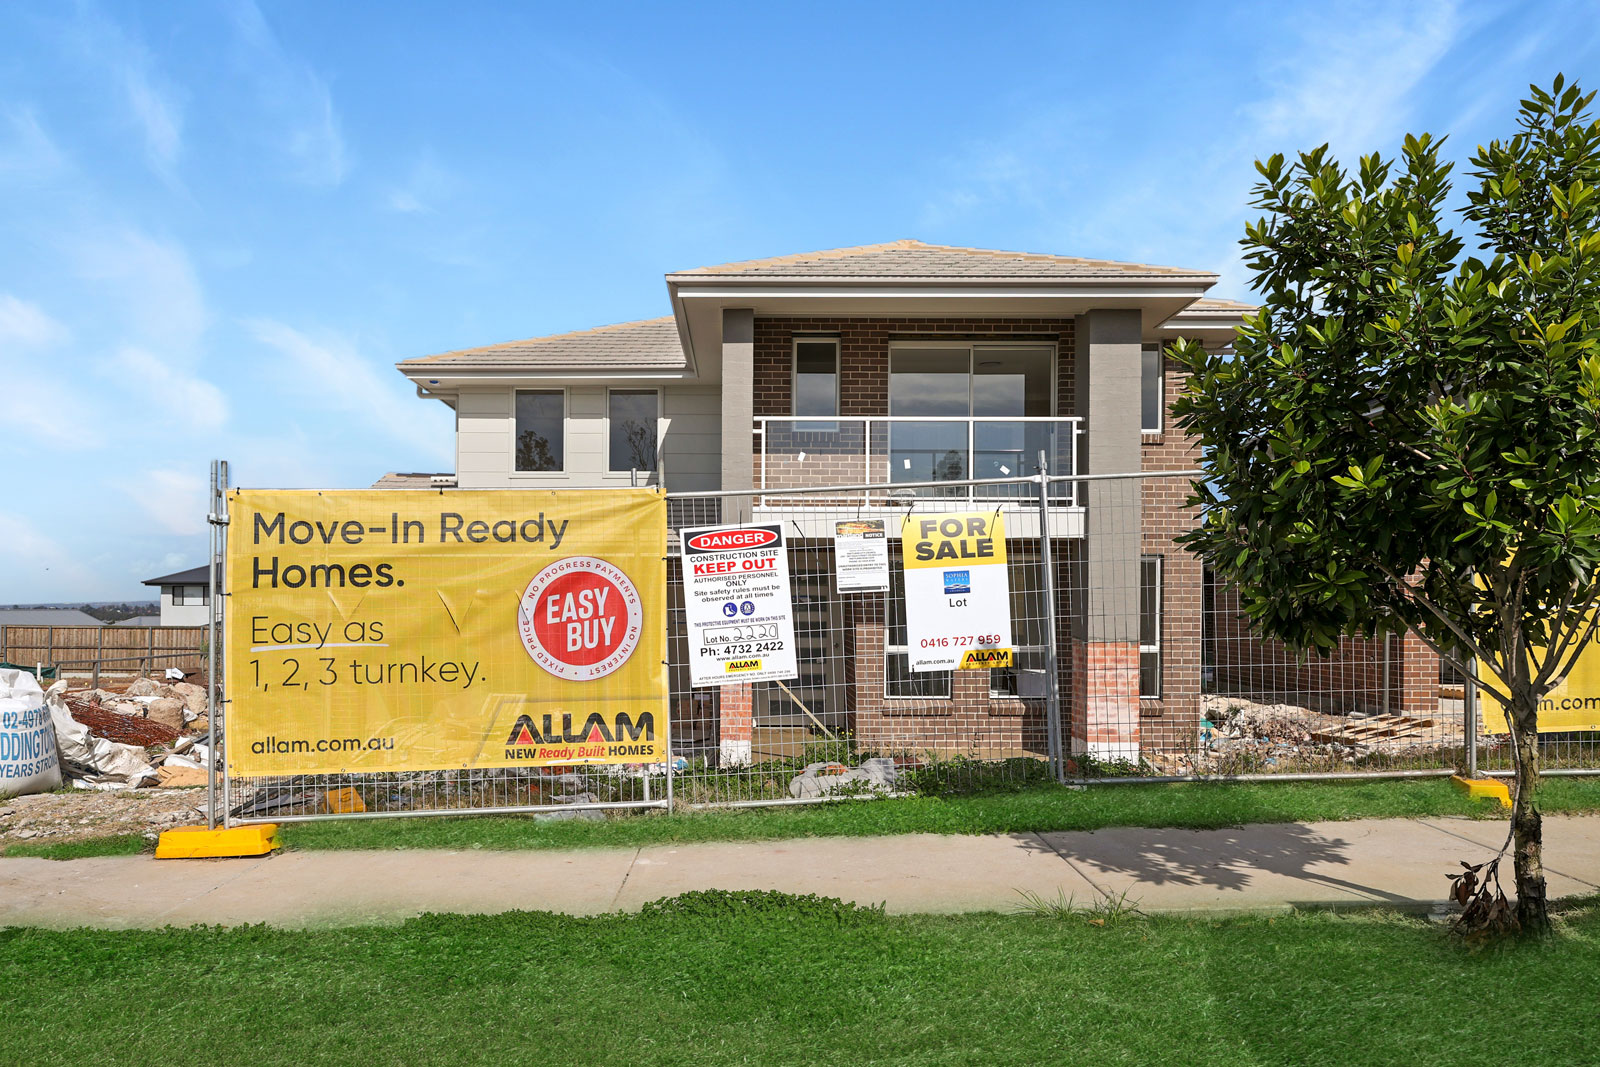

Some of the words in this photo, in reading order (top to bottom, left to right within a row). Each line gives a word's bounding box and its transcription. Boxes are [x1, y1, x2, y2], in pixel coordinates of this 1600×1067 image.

[253, 511, 425, 545] Move-In
[439, 511, 569, 550] Ready
[920, 517, 987, 540] FOR
[700, 532, 765, 548] DANGER
[690, 551, 758, 563] CONSTRUCTION
[760, 549, 779, 557] SITE
[915, 538, 994, 561] SALE
[252, 556, 405, 589] Homes.
[694, 561, 736, 574] KEEP
[742, 558, 776, 570] OUT
[528, 585, 539, 599] NO
[539, 561, 591, 583] PROGRESS
[595, 563, 636, 604] PAYMENTS
[694, 575, 737, 584] AUTHORISED
[739, 571, 778, 579] PERSONNEL
[725, 579, 747, 587] ONLY
[701, 595, 734, 603] observed
[710, 588, 731, 596] safety
[546, 586, 610, 625] EASY
[949, 598, 968, 608] Lot
[251, 616, 332, 650] Easy
[344, 620, 384, 643] as
[523, 620, 537, 650] PRICE
[567, 616, 616, 652] BUY
[628, 626, 638, 640] NO
[706, 636, 718, 644] Lot
[733, 624, 777, 641] 2220
[700, 646, 720, 657] Ph:
[724, 643, 752, 655] 4732
[756, 641, 784, 652] 2422
[920, 637, 949, 648] 0416
[952, 635, 974, 646] 727
[977, 634, 1001, 645] 959
[537, 652, 565, 673] FIXED
[589, 643, 631, 676] INTEREST
[716, 653, 770, 662] www.allam.com.au
[728, 660, 759, 669] ALLAM
[915, 658, 955, 666] allam.com.au
[966, 651, 1008, 662] ALLAM
[250, 659, 268, 691] 1,
[282, 658, 308, 691] 2,
[319, 657, 338, 686] 3
[349, 656, 487, 689] turnkey.
[505, 711, 655, 745] ALLAM
[251, 735, 395, 755] allam.com.au
[505, 748, 536, 760] NEW
[539, 747, 575, 760] Ready
[577, 746, 606, 758] Built
[608, 745, 654, 756] HOMES
[0, 762, 33, 778] YEARS
